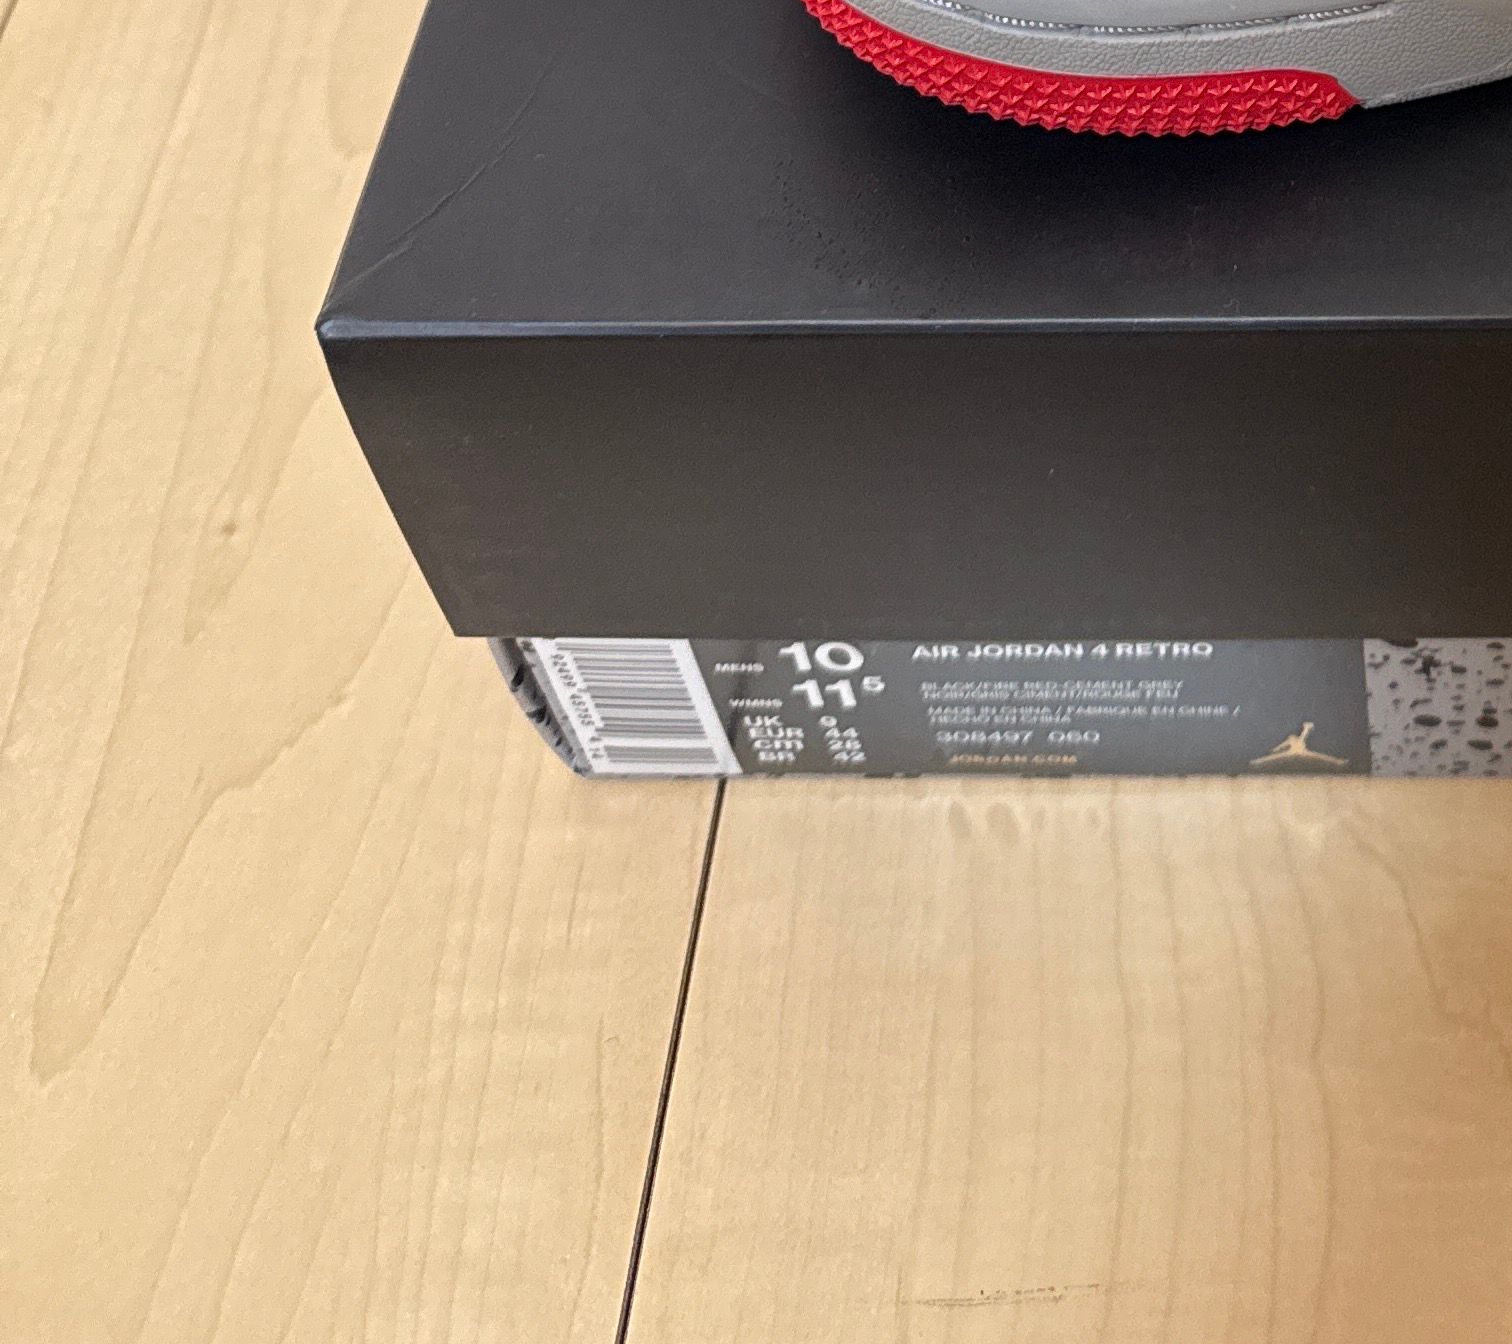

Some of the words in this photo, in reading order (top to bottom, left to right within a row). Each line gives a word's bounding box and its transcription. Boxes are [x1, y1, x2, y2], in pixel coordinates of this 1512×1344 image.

[912, 644, 960, 660] AIR
[967, 643, 1084, 660] JORDAN
[1090, 643, 1109, 658] 4
[1115, 642, 1214, 659] RETRO
[714, 663, 765, 674] MENS
[778, 641, 864, 671] 10
[743, 715, 783, 727] UK
[750, 727, 804, 739] EUR
[825, 727, 859, 739] 44
[833, 751, 867, 762] 42
